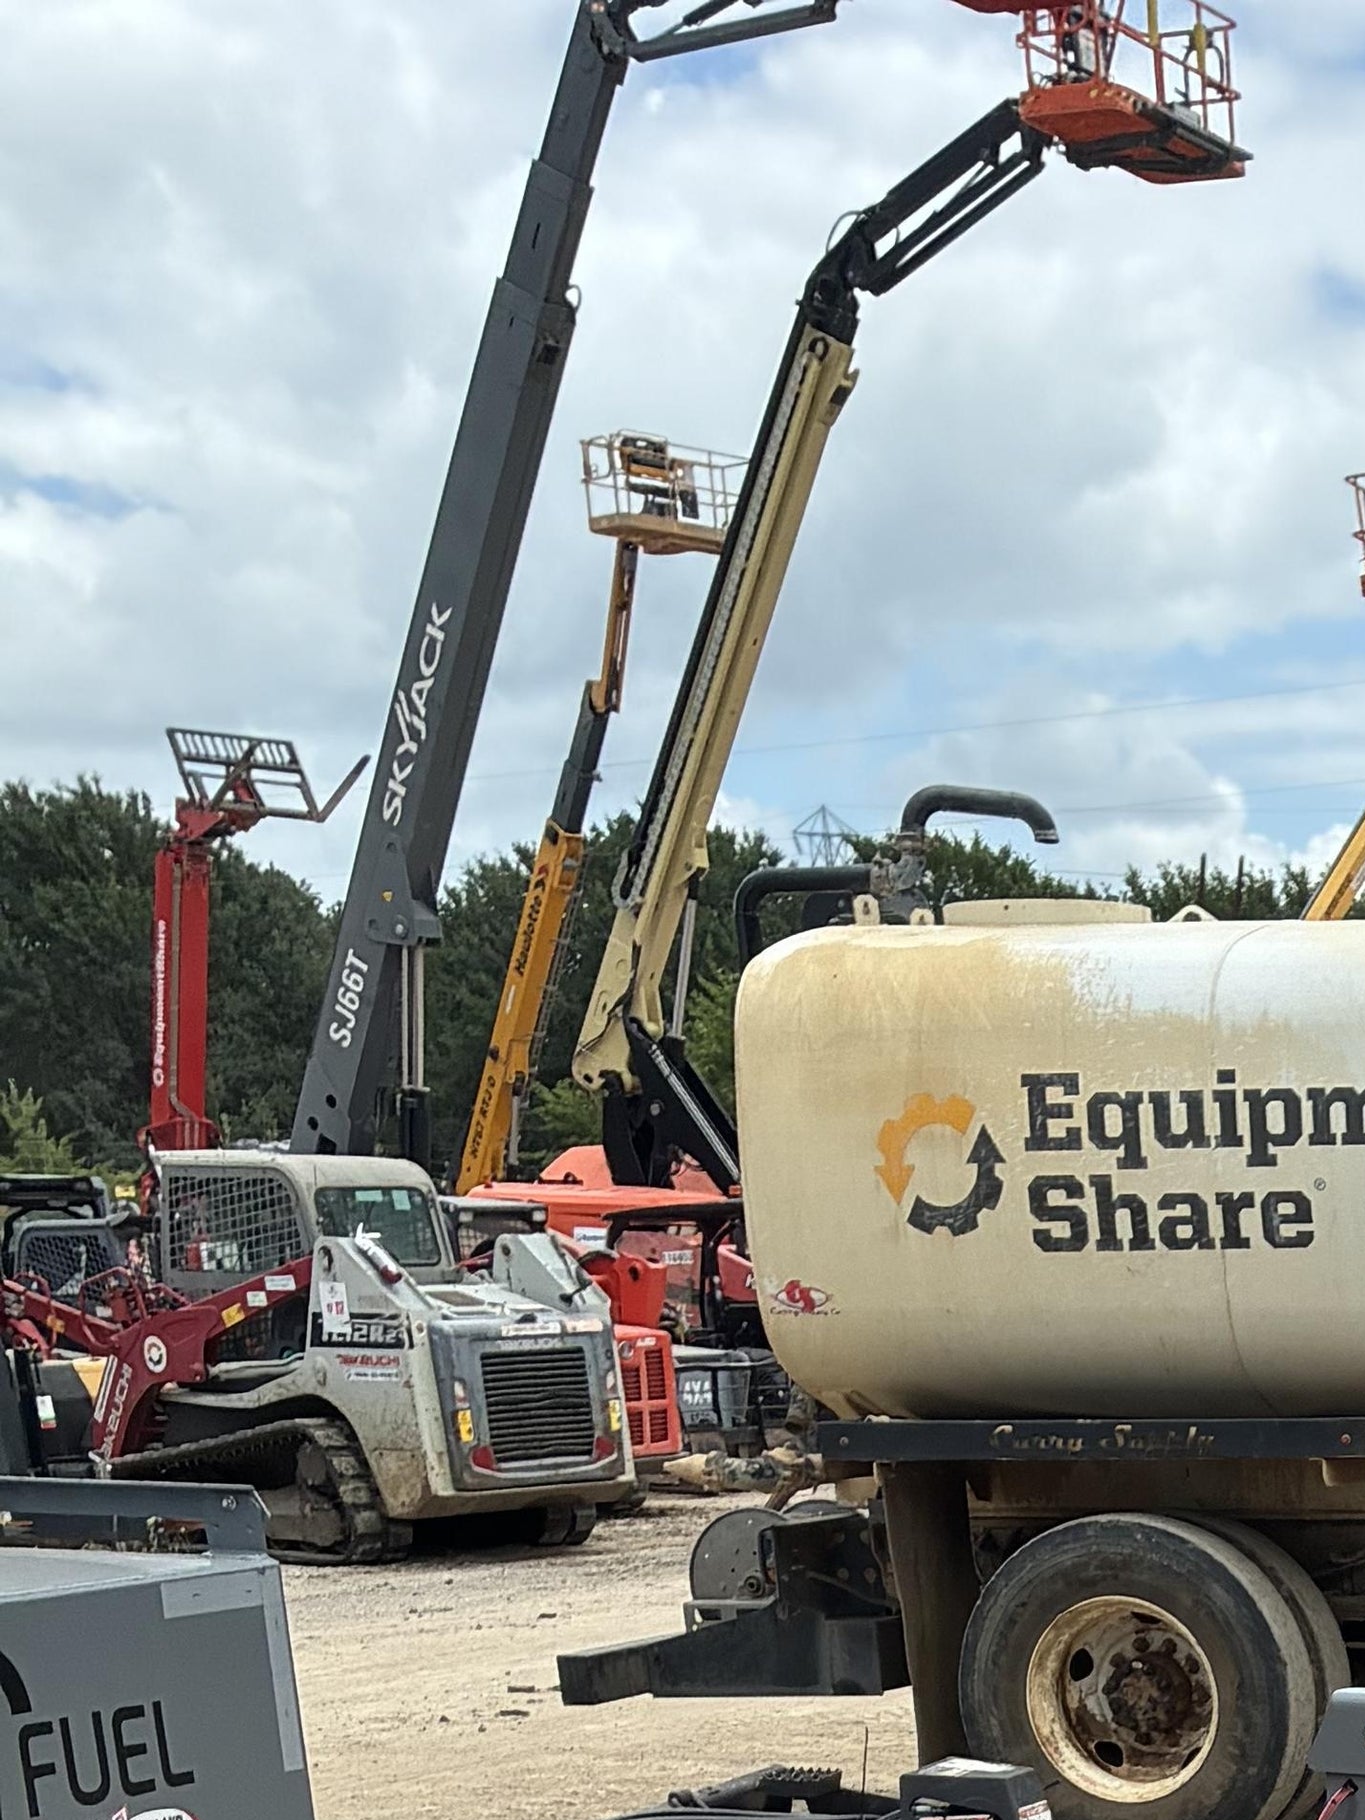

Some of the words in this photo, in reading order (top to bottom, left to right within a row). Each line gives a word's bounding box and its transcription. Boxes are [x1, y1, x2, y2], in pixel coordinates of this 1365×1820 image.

[383, 602, 452, 826] SKYJACK
[515, 895, 542, 976] Haulotte
[330, 948, 369, 1049] SJ66T
[1027, 1174, 1315, 1253] Share
[18, 1700, 196, 1818] FUEL
